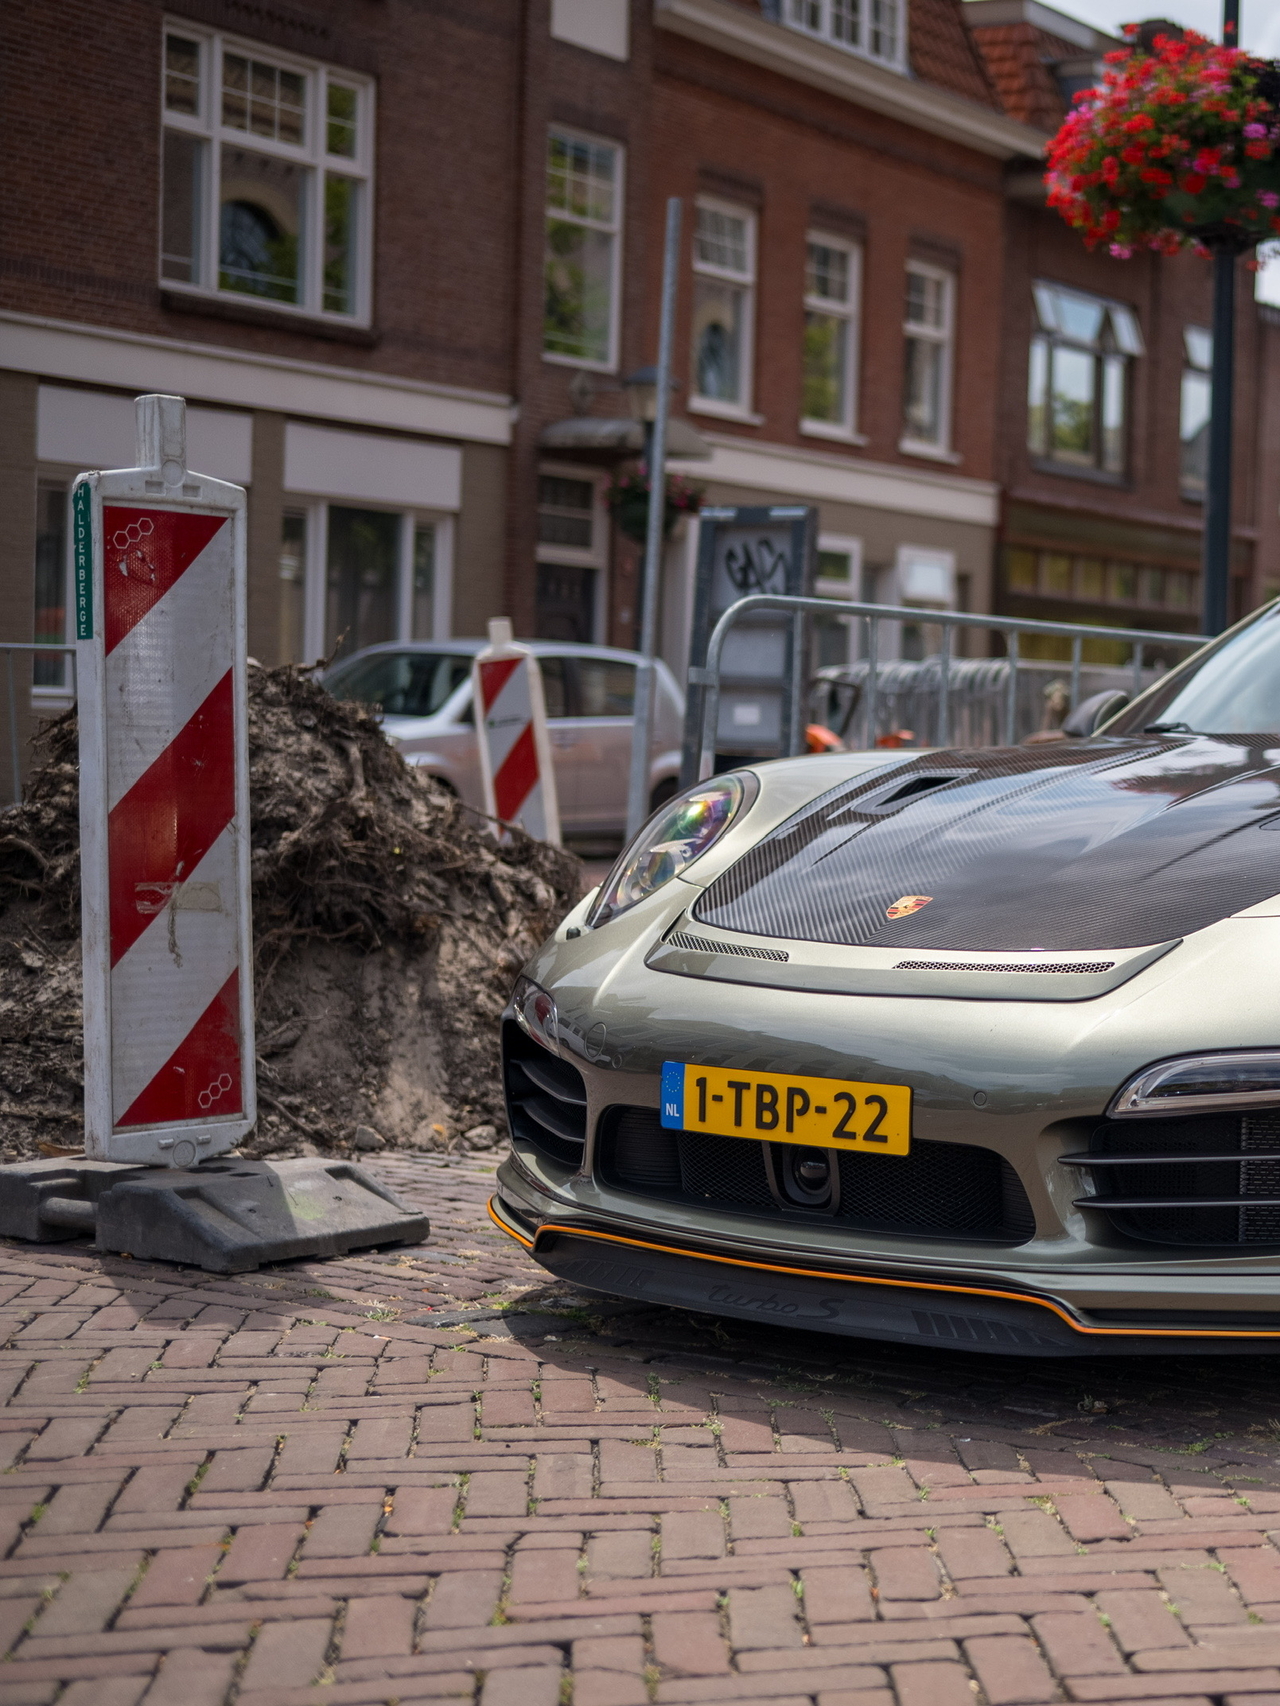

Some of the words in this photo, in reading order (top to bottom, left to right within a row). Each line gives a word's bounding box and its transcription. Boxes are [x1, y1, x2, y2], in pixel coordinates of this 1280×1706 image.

[77, 487, 87, 636] HALDERBERGE
[665, 1103, 680, 1117] NL
[696, 1077, 888, 1143] 1-TBP-22
[796, 1299, 845, 1320] S
